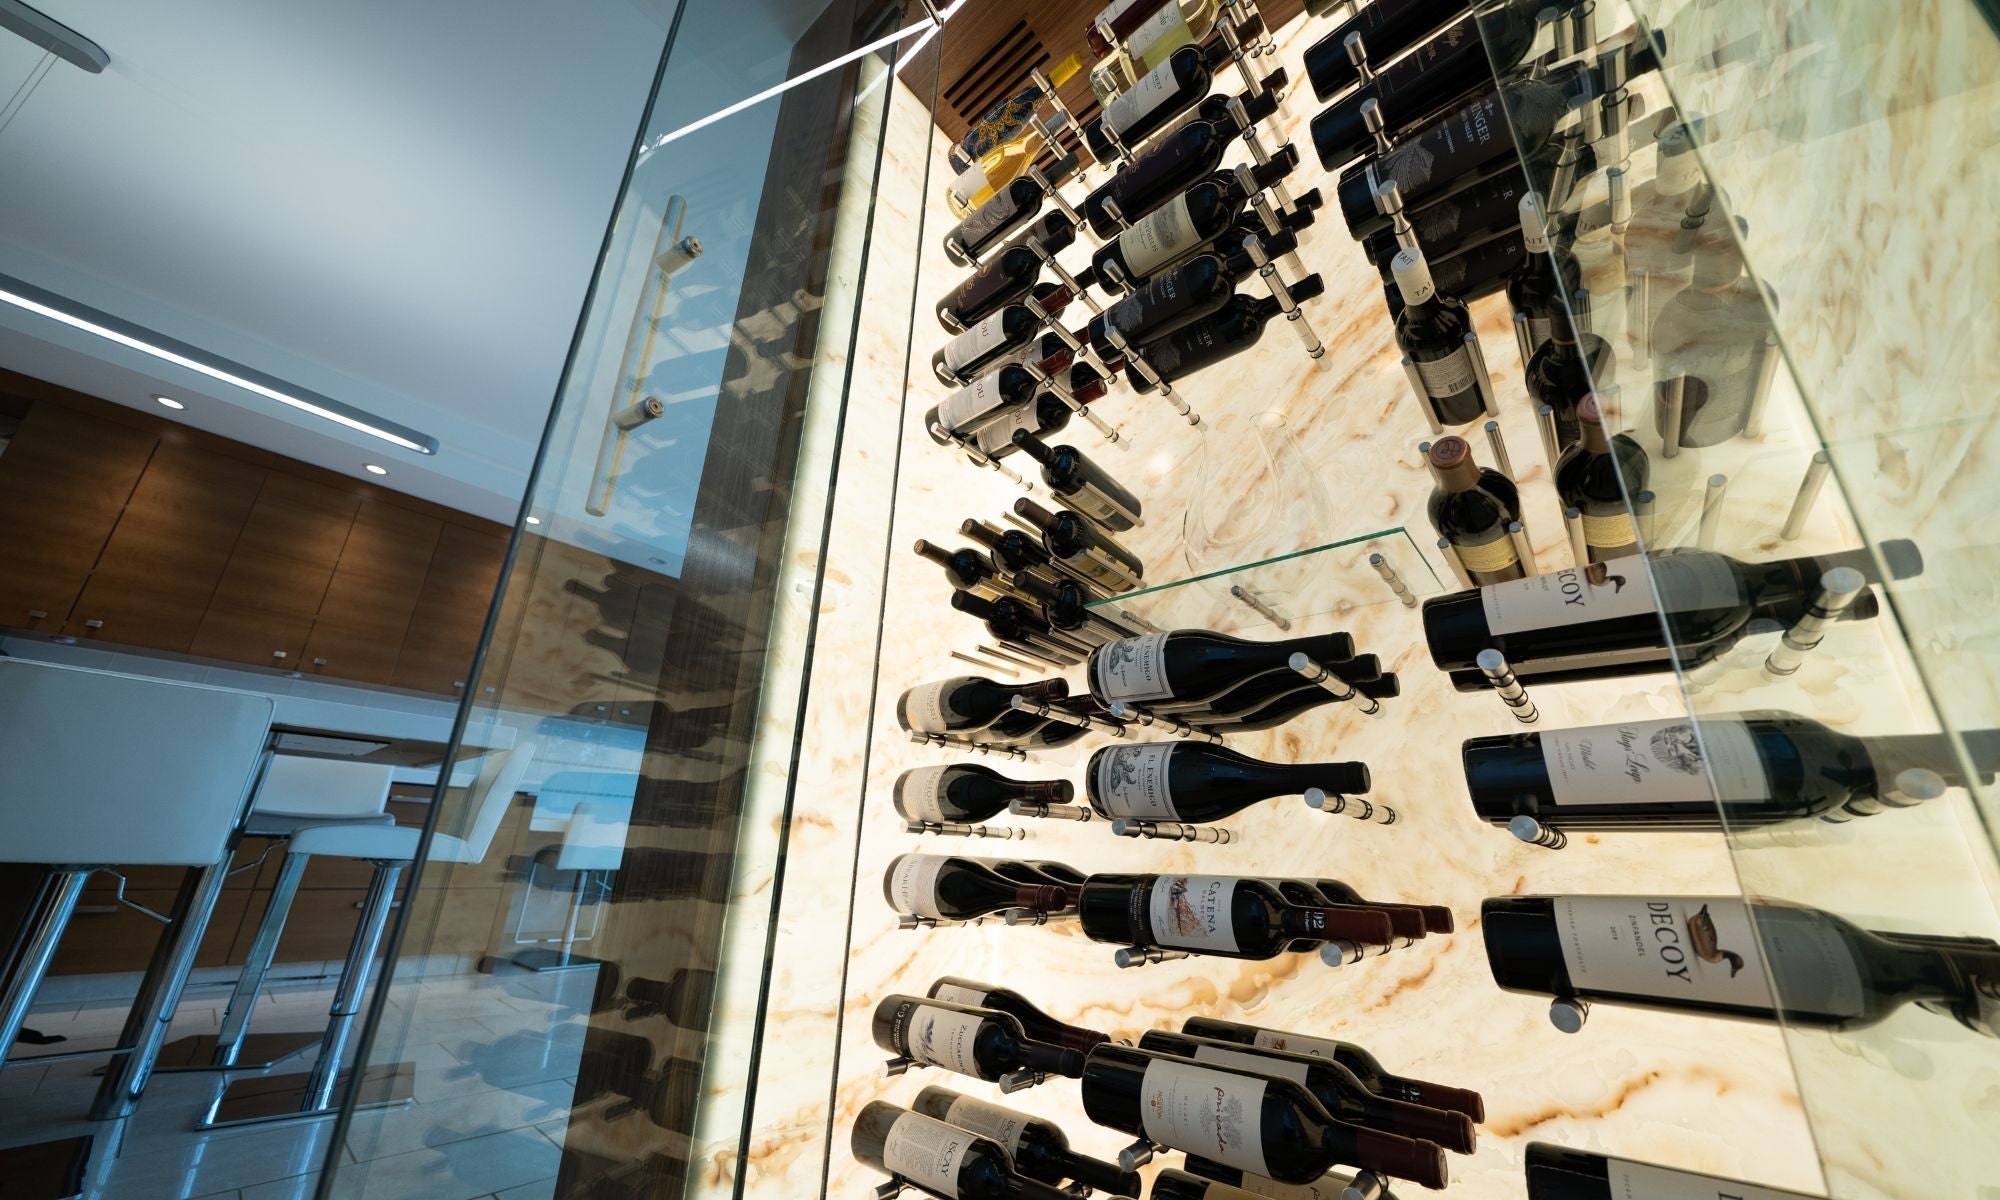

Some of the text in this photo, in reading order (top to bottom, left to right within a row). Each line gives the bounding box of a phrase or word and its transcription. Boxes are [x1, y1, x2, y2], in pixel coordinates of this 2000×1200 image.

[1471, 102, 1490, 145] RINGER
[1525, 235, 1546, 246] AIT
[1415, 282, 1431, 297] TAI
[1557, 568, 1586, 607] ECOY
[1143, 645, 1152, 681] ENEMIGO
[1146, 767, 1157, 807] ENEMIGO
[1200, 889, 1208, 921] MALBEC
[1206, 881, 1220, 933] CATENA
[1628, 914, 1646, 957] ZINFANDEL
[1647, 902, 1692, 984] DECOY
[1000, 1119, 1016, 1147] ISCA
[942, 1141, 959, 1178] ISCAY
